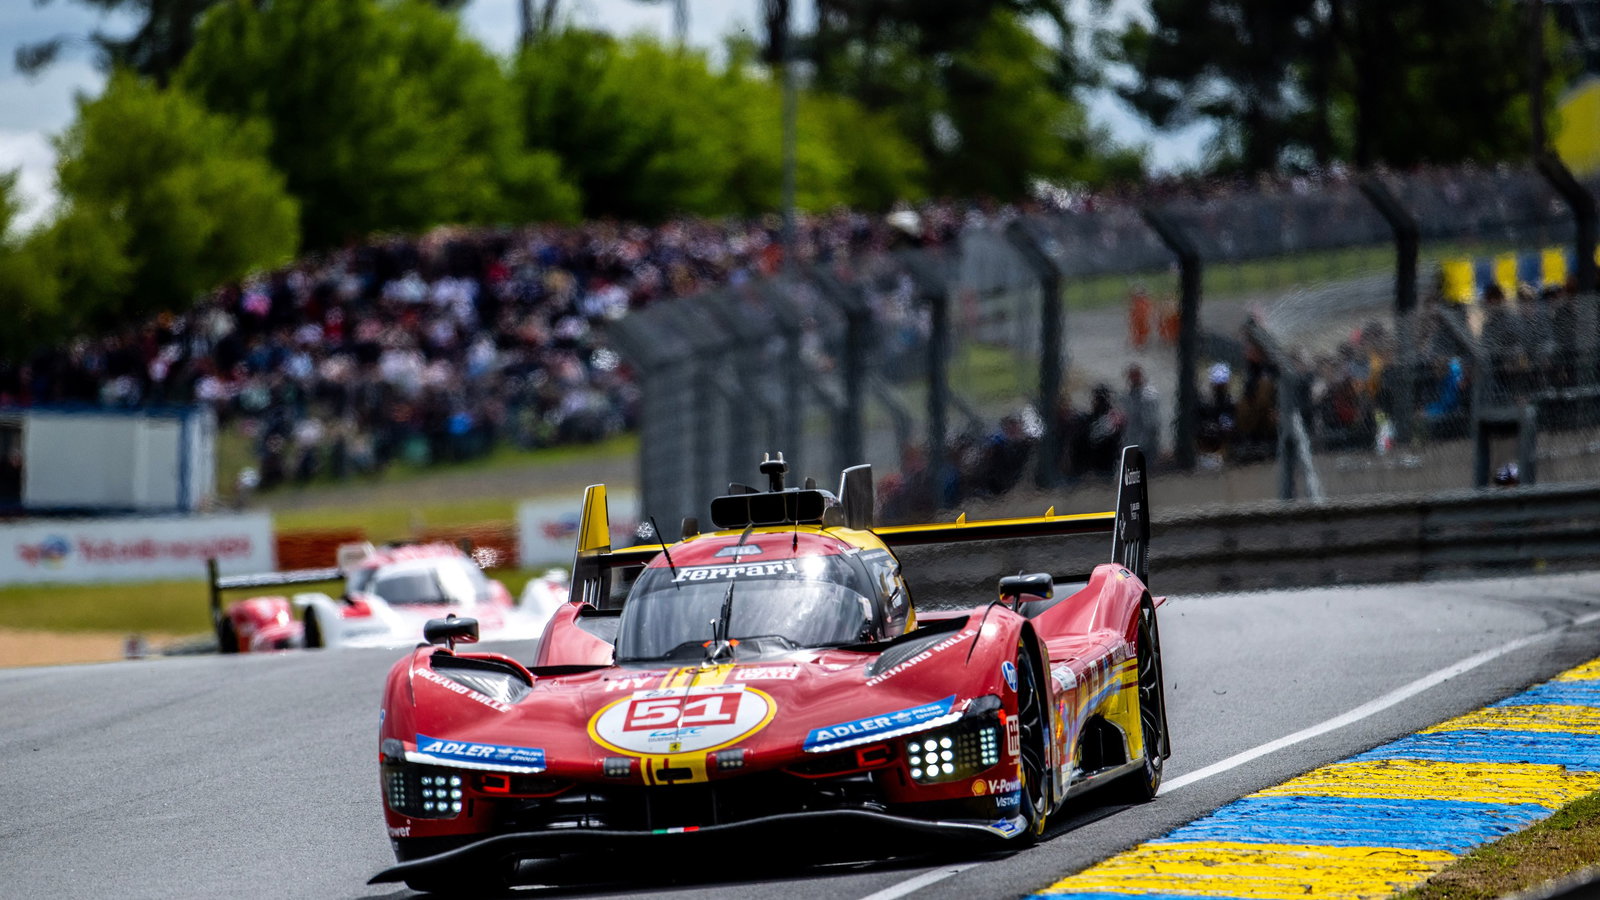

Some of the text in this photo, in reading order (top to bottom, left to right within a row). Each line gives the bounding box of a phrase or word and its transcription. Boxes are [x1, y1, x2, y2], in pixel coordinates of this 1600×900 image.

[671, 560, 798, 583] Ferrari
[866, 628, 978, 687] RICHARD MILLE
[414, 667, 513, 713] RICHARD MILLE
[605, 676, 654, 692] HY
[630, 695, 732, 728] 51
[816, 716, 893, 742] ADLER
[422, 741, 496, 758] ADLER
